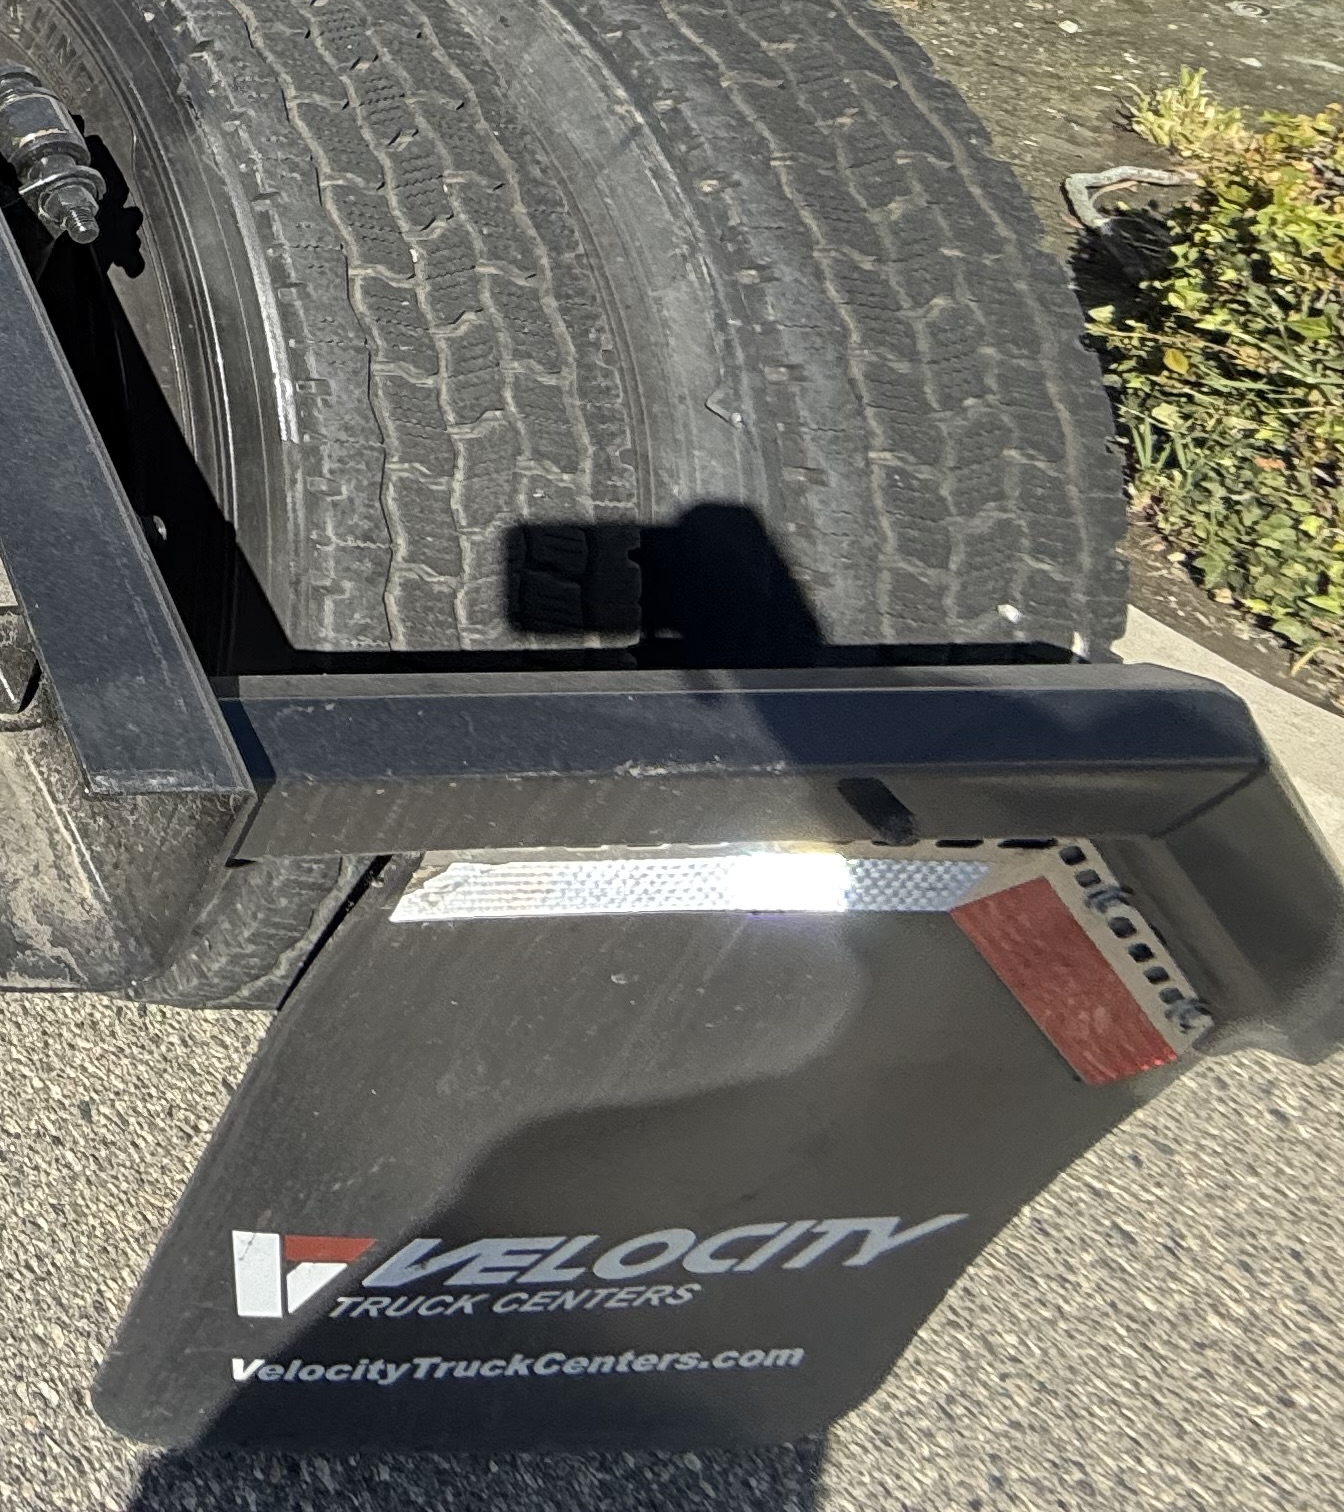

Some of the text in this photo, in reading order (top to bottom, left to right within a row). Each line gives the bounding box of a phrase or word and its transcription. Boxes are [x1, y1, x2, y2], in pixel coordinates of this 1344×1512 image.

[362, 1213, 969, 1287] VELOCITY
[330, 1283, 703, 1318] TRUCK CENTERS
[232, 1347, 805, 1385] VelocityTruckCenters.com
